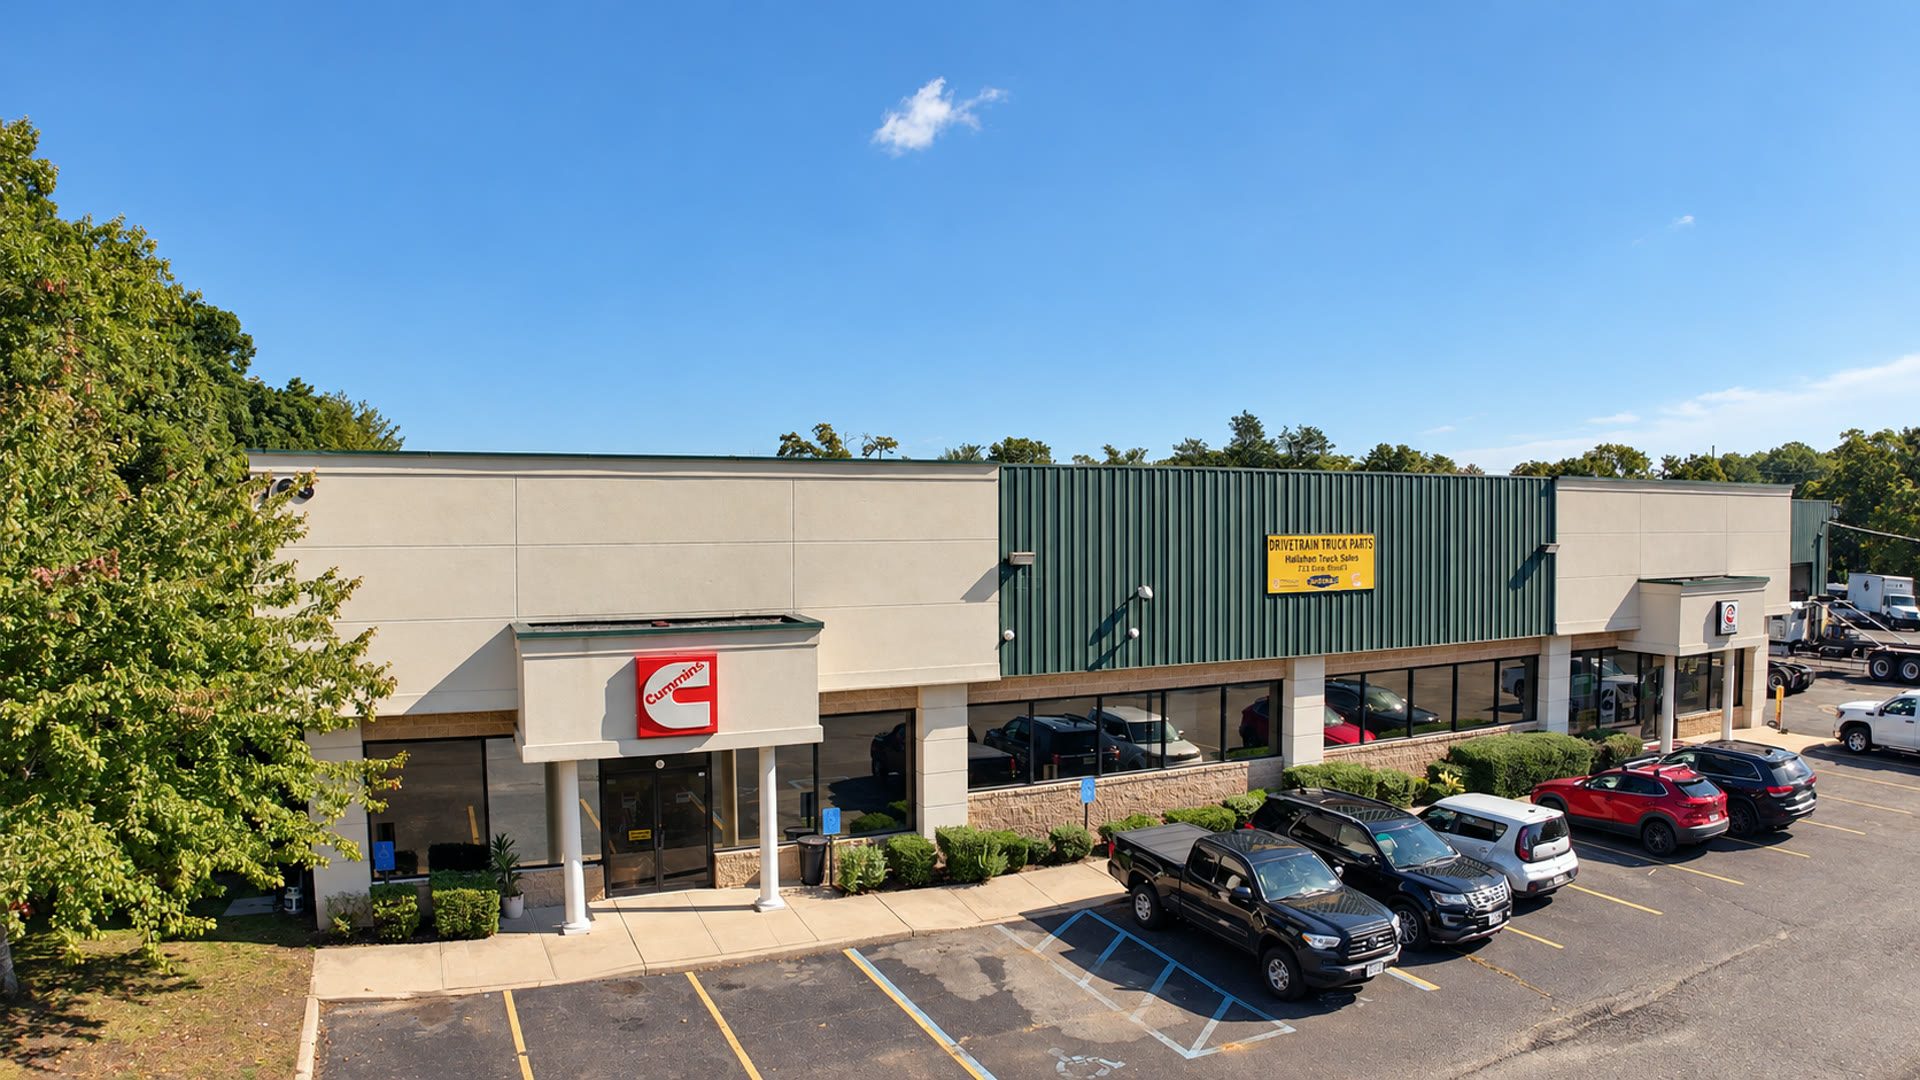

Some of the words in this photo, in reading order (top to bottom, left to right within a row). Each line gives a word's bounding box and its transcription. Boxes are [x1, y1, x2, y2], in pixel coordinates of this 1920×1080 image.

[1269, 538, 1319, 551] DRIVETRAIN
[1321, 538, 1348, 550] TRUCK
[1349, 537, 1373, 549] PARTS
[1319, 554, 1339, 562] Truck
[1340, 553, 1359, 562] Sales
[645, 661, 705, 705] Cummins
